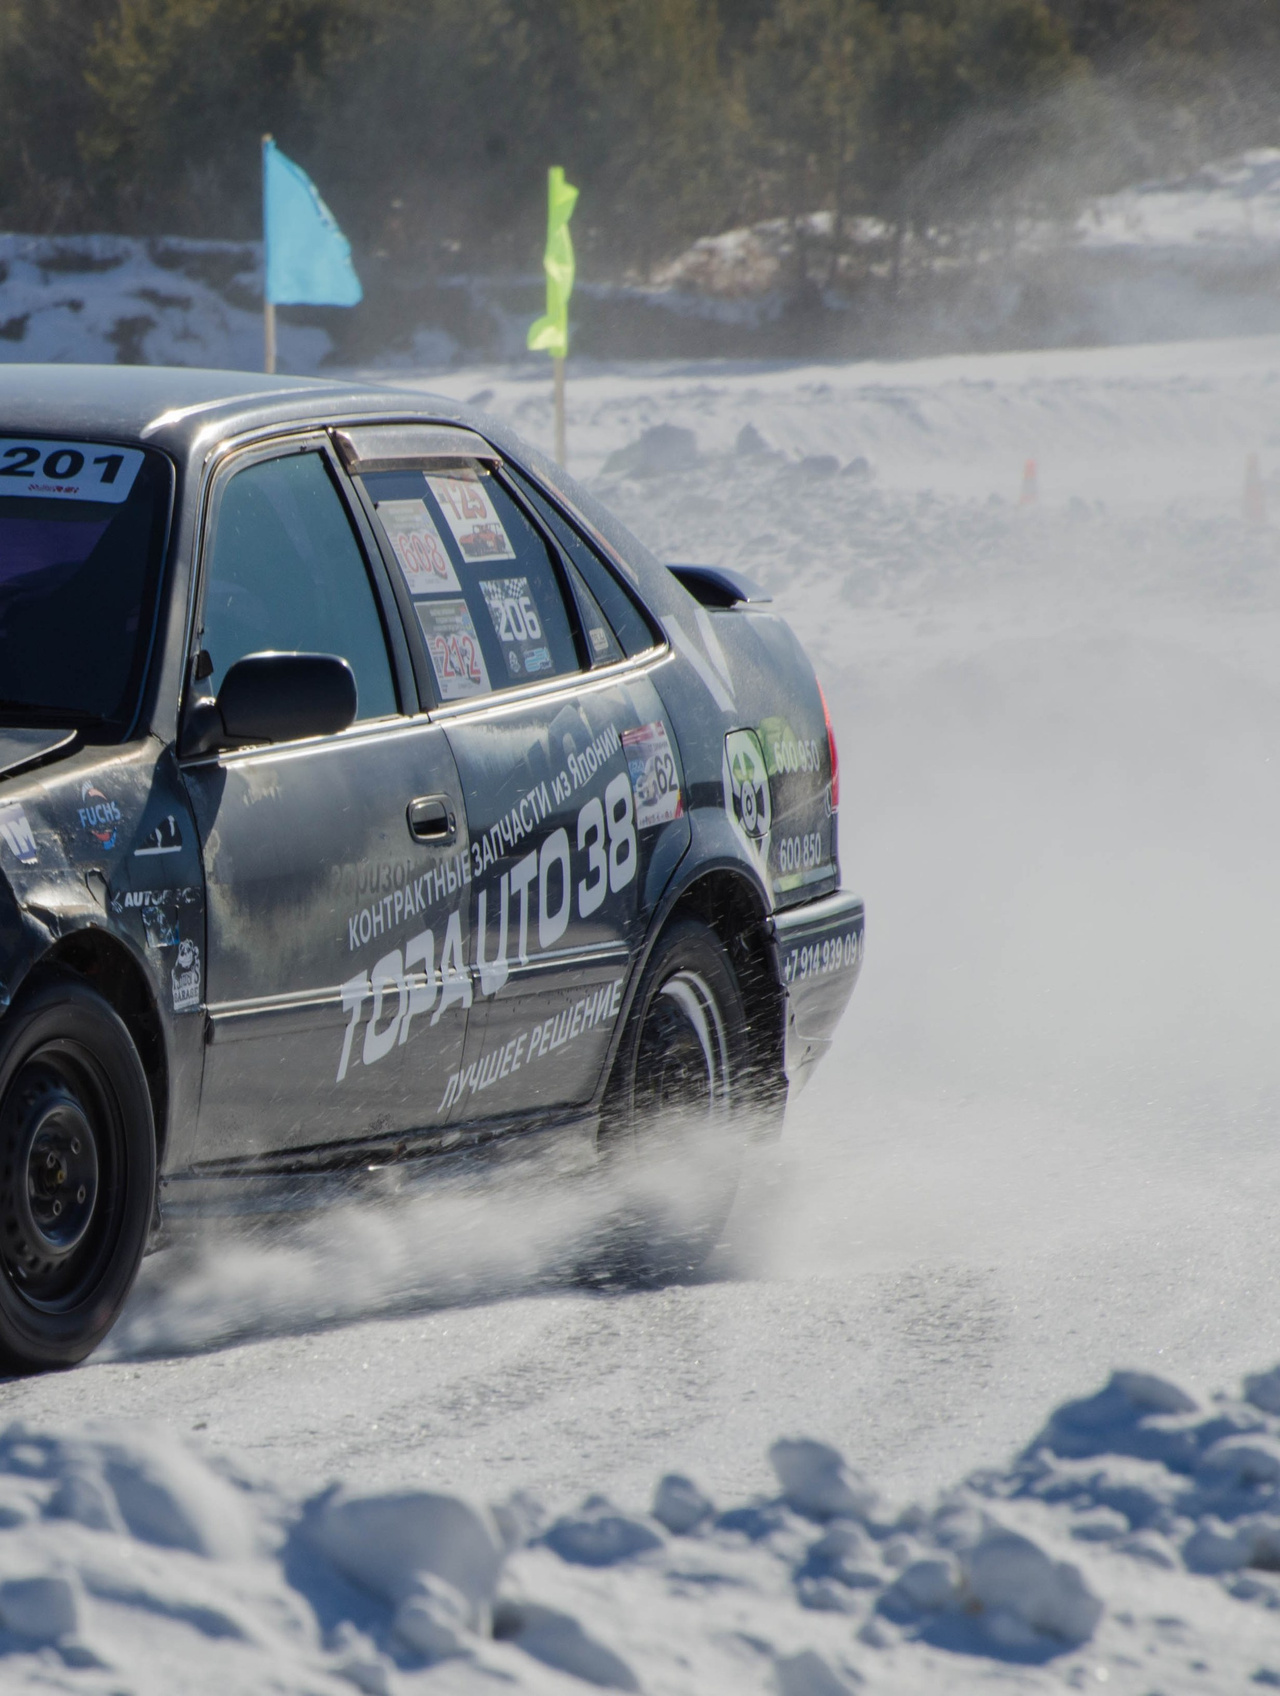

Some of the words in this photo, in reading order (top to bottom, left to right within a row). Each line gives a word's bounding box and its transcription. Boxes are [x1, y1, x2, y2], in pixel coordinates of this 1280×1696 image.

[399, 534, 446, 573] 608
[490, 597, 541, 641] 206
[436, 636, 481, 677] 212
[654, 753, 678, 794] 62
[774, 740, 798, 774] 600
[798, 739, 820, 773] 950
[78, 800, 121, 829] FUCHS
[348, 849, 471, 951] КОНТРАКТНЫЕ
[471, 785, 549, 877] ЗАПЧАСТИ
[780, 836, 801, 872] 600
[803, 832, 821, 867] 850
[785, 949, 798, 982] +7
[800, 943, 820, 980] 914
[823, 936, 842, 973] 939
[844, 931, 857, 966] 09
[437, 1031, 526, 1113] ЛУЧШЕЕ
[525, 979, 624, 1063] РЕШЕНИЕ
